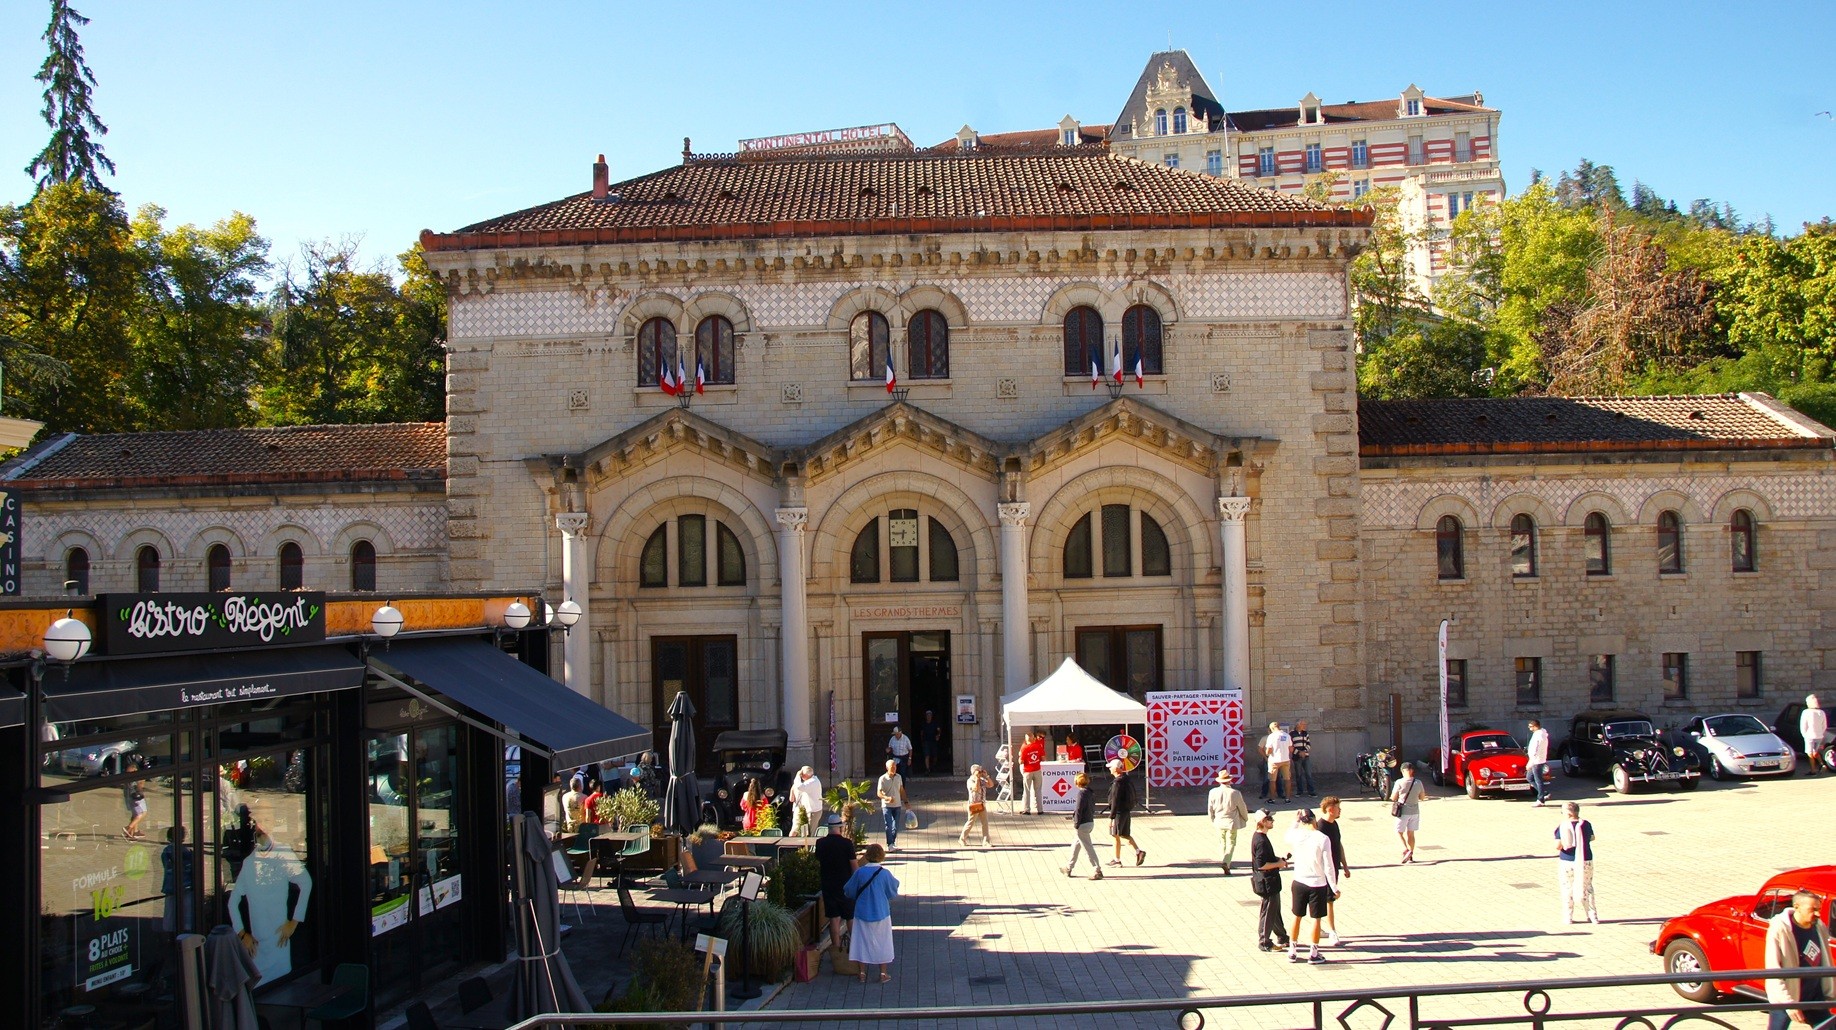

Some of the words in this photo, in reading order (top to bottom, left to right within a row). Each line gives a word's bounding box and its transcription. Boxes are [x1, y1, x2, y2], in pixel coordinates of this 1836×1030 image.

[746, 132, 835, 150] CONTINENTAL
[841, 126, 883, 140] HOTEL
[5, 498, 15, 592] CASINO
[128, 600, 210, 639] bistro
[224, 596, 309, 642] Régent
[854, 609, 872, 618] LES
[874, 608, 912, 617] GRANDS
[913, 606, 959, 616] THERMES
[191, 689, 223, 701] restaurant
[225, 687, 236, 698] tout
[72, 866, 119, 892] FORMULE
[88, 938, 101, 962] 8
[101, 928, 128, 950] PLATS
